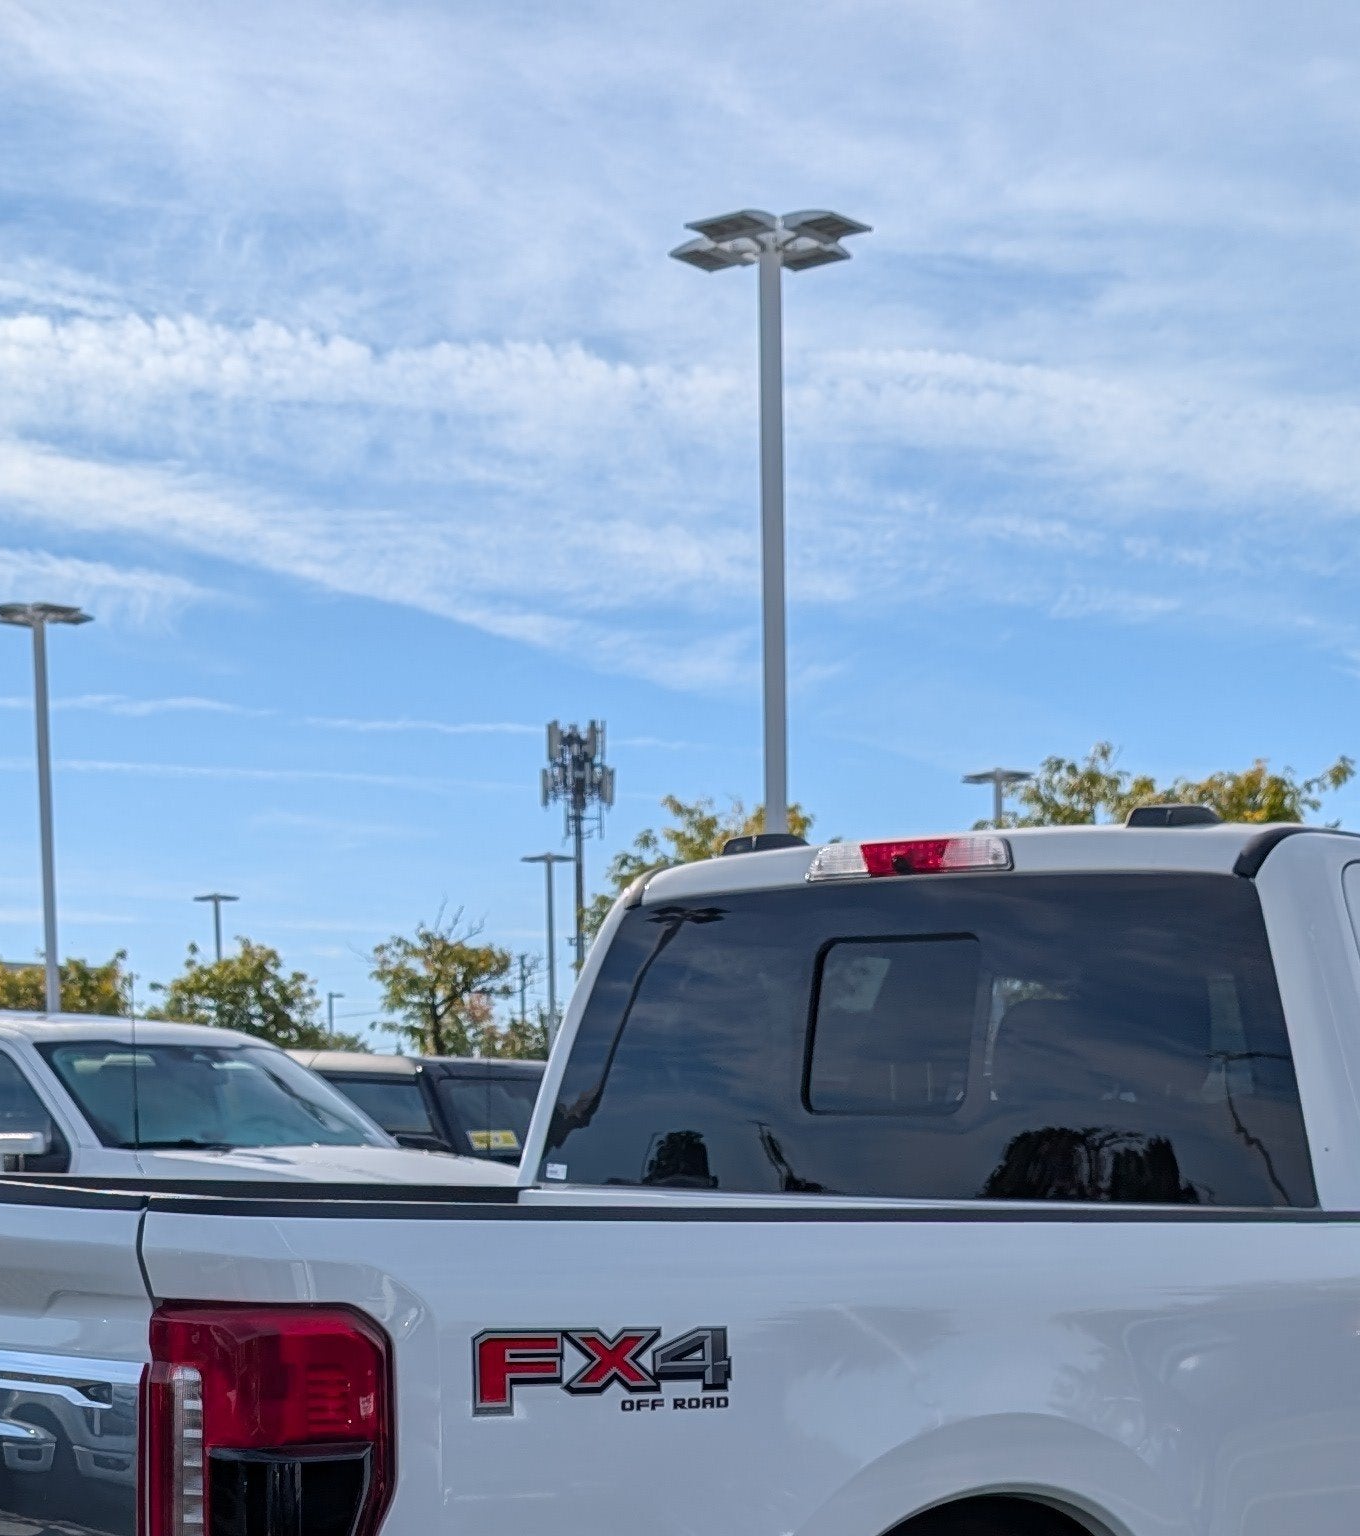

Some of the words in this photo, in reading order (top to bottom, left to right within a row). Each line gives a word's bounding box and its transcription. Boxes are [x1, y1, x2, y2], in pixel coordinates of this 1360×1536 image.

[472, 1326, 732, 1417] FX4
[621, 1399, 664, 1412] OFF
[673, 1397, 729, 1410] ROAD
